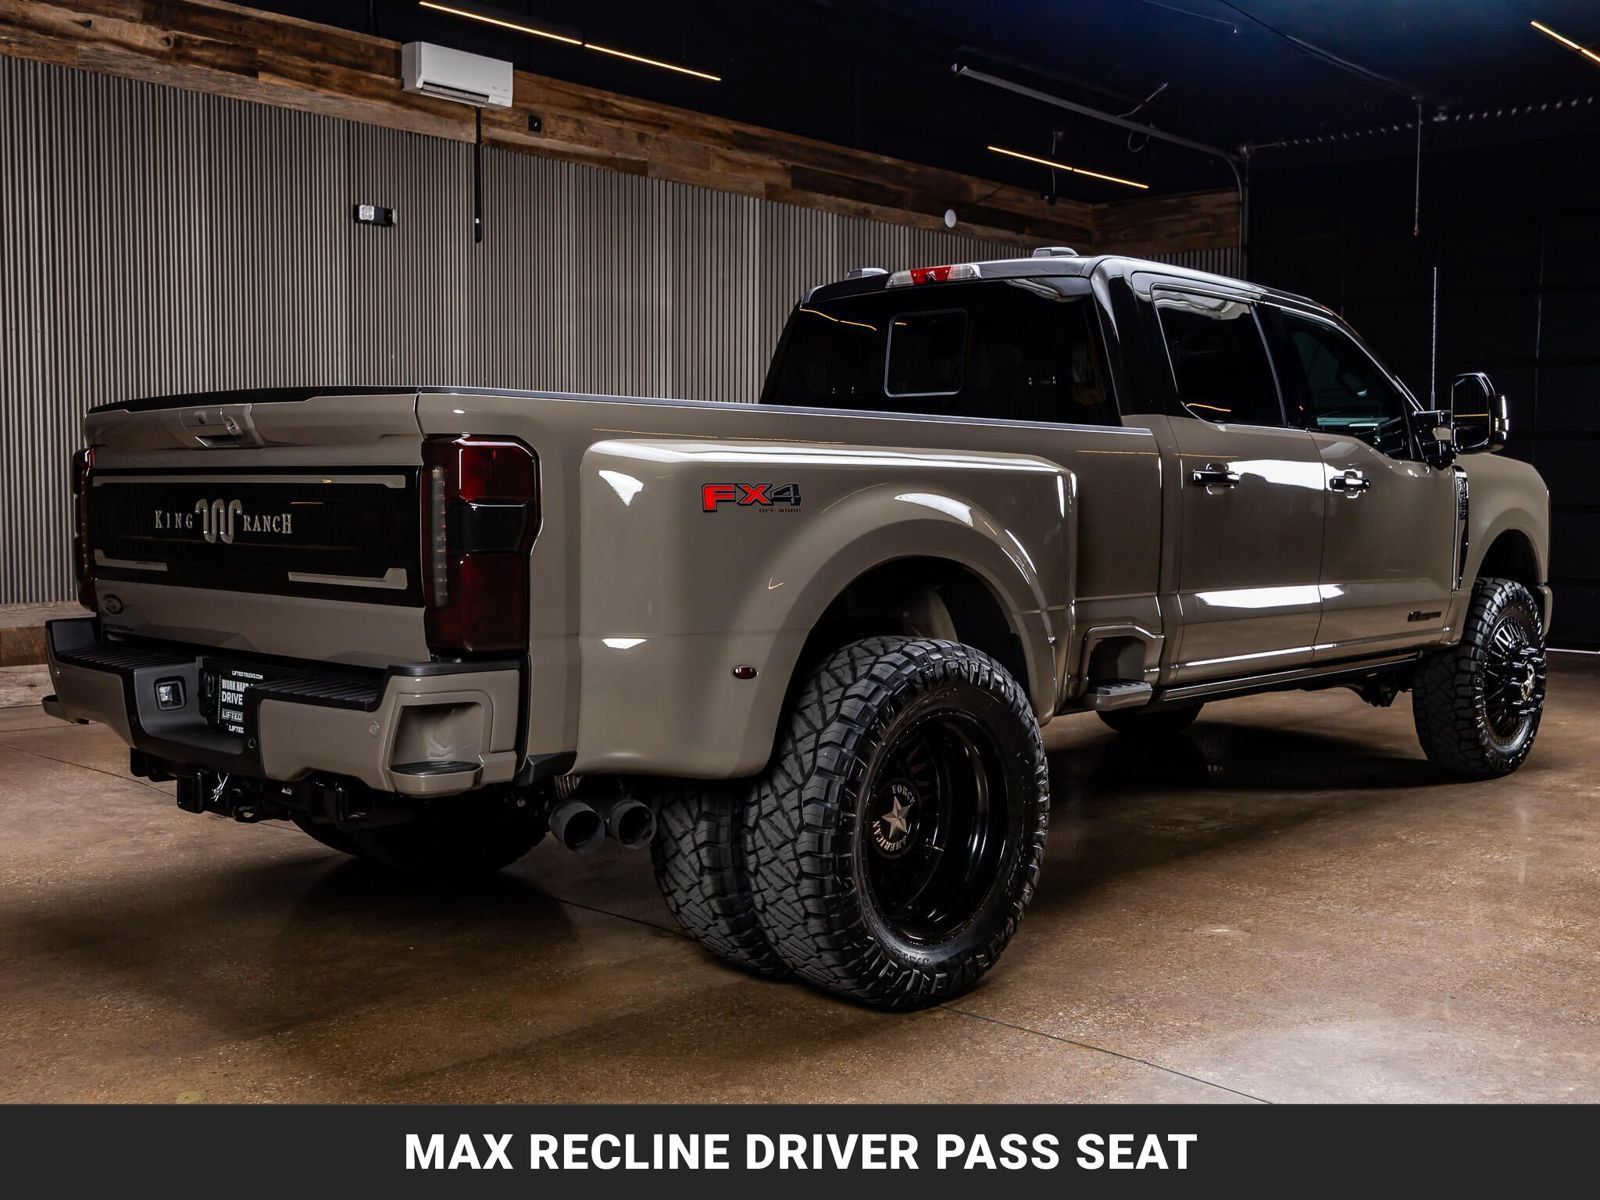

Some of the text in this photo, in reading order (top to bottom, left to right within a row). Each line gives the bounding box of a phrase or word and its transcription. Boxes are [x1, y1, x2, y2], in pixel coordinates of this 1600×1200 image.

[701, 483, 801, 512] FX4
[155, 510, 292, 534] KING RANCH
[222, 691, 243, 706] DRIVE
[892, 785, 916, 805] FORCE
